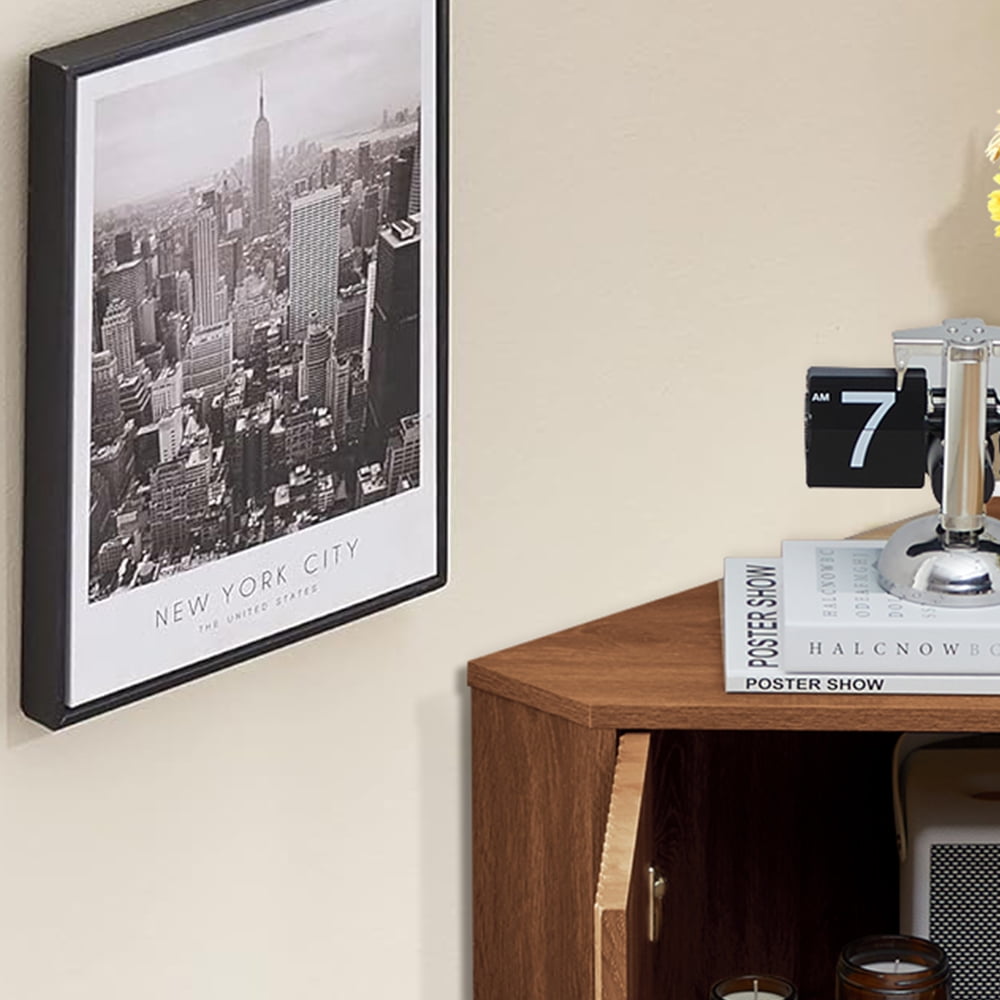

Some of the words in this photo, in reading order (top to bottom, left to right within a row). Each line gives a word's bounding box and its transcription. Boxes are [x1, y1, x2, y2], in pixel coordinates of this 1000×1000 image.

[811, 392, 830, 401] AM
[841, 391, 896, 468] 7
[155, 593, 209, 628] NEW
[222, 565, 288, 604] YORK
[304, 538, 359, 574] CITY
[199, 620, 218, 633] THE
[227, 602, 268, 624] UNITED
[275, 584, 318, 606] STATES
[746, 564, 777, 608] SHOW
[746, 611, 779, 668] POSTER
[746, 678, 821, 690] POSTER
[827, 678, 884, 690] SHOW
